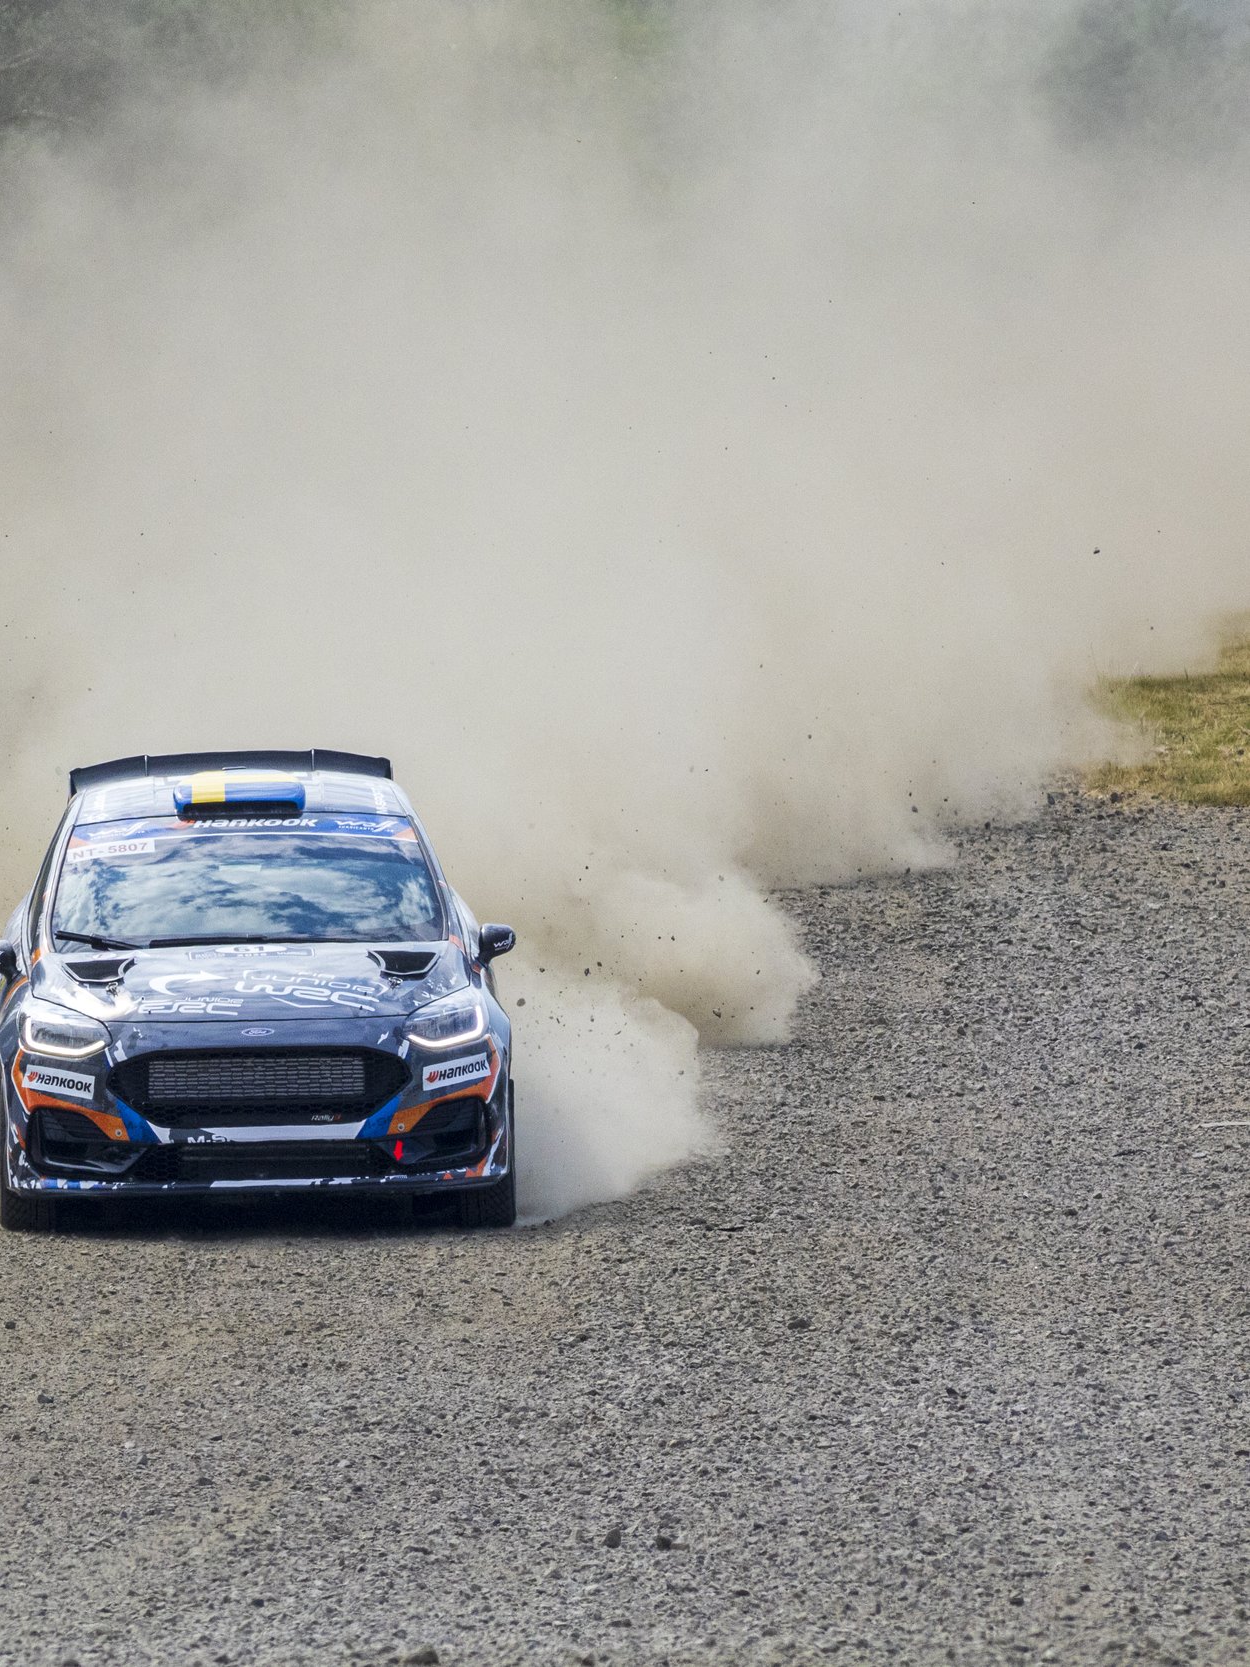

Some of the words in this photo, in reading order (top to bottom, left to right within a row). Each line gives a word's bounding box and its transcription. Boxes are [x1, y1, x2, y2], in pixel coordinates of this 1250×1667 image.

[250, 975, 376, 994] JUNIOR
[234, 981, 380, 1012] WRC
[138, 1001, 242, 1016] ERC
